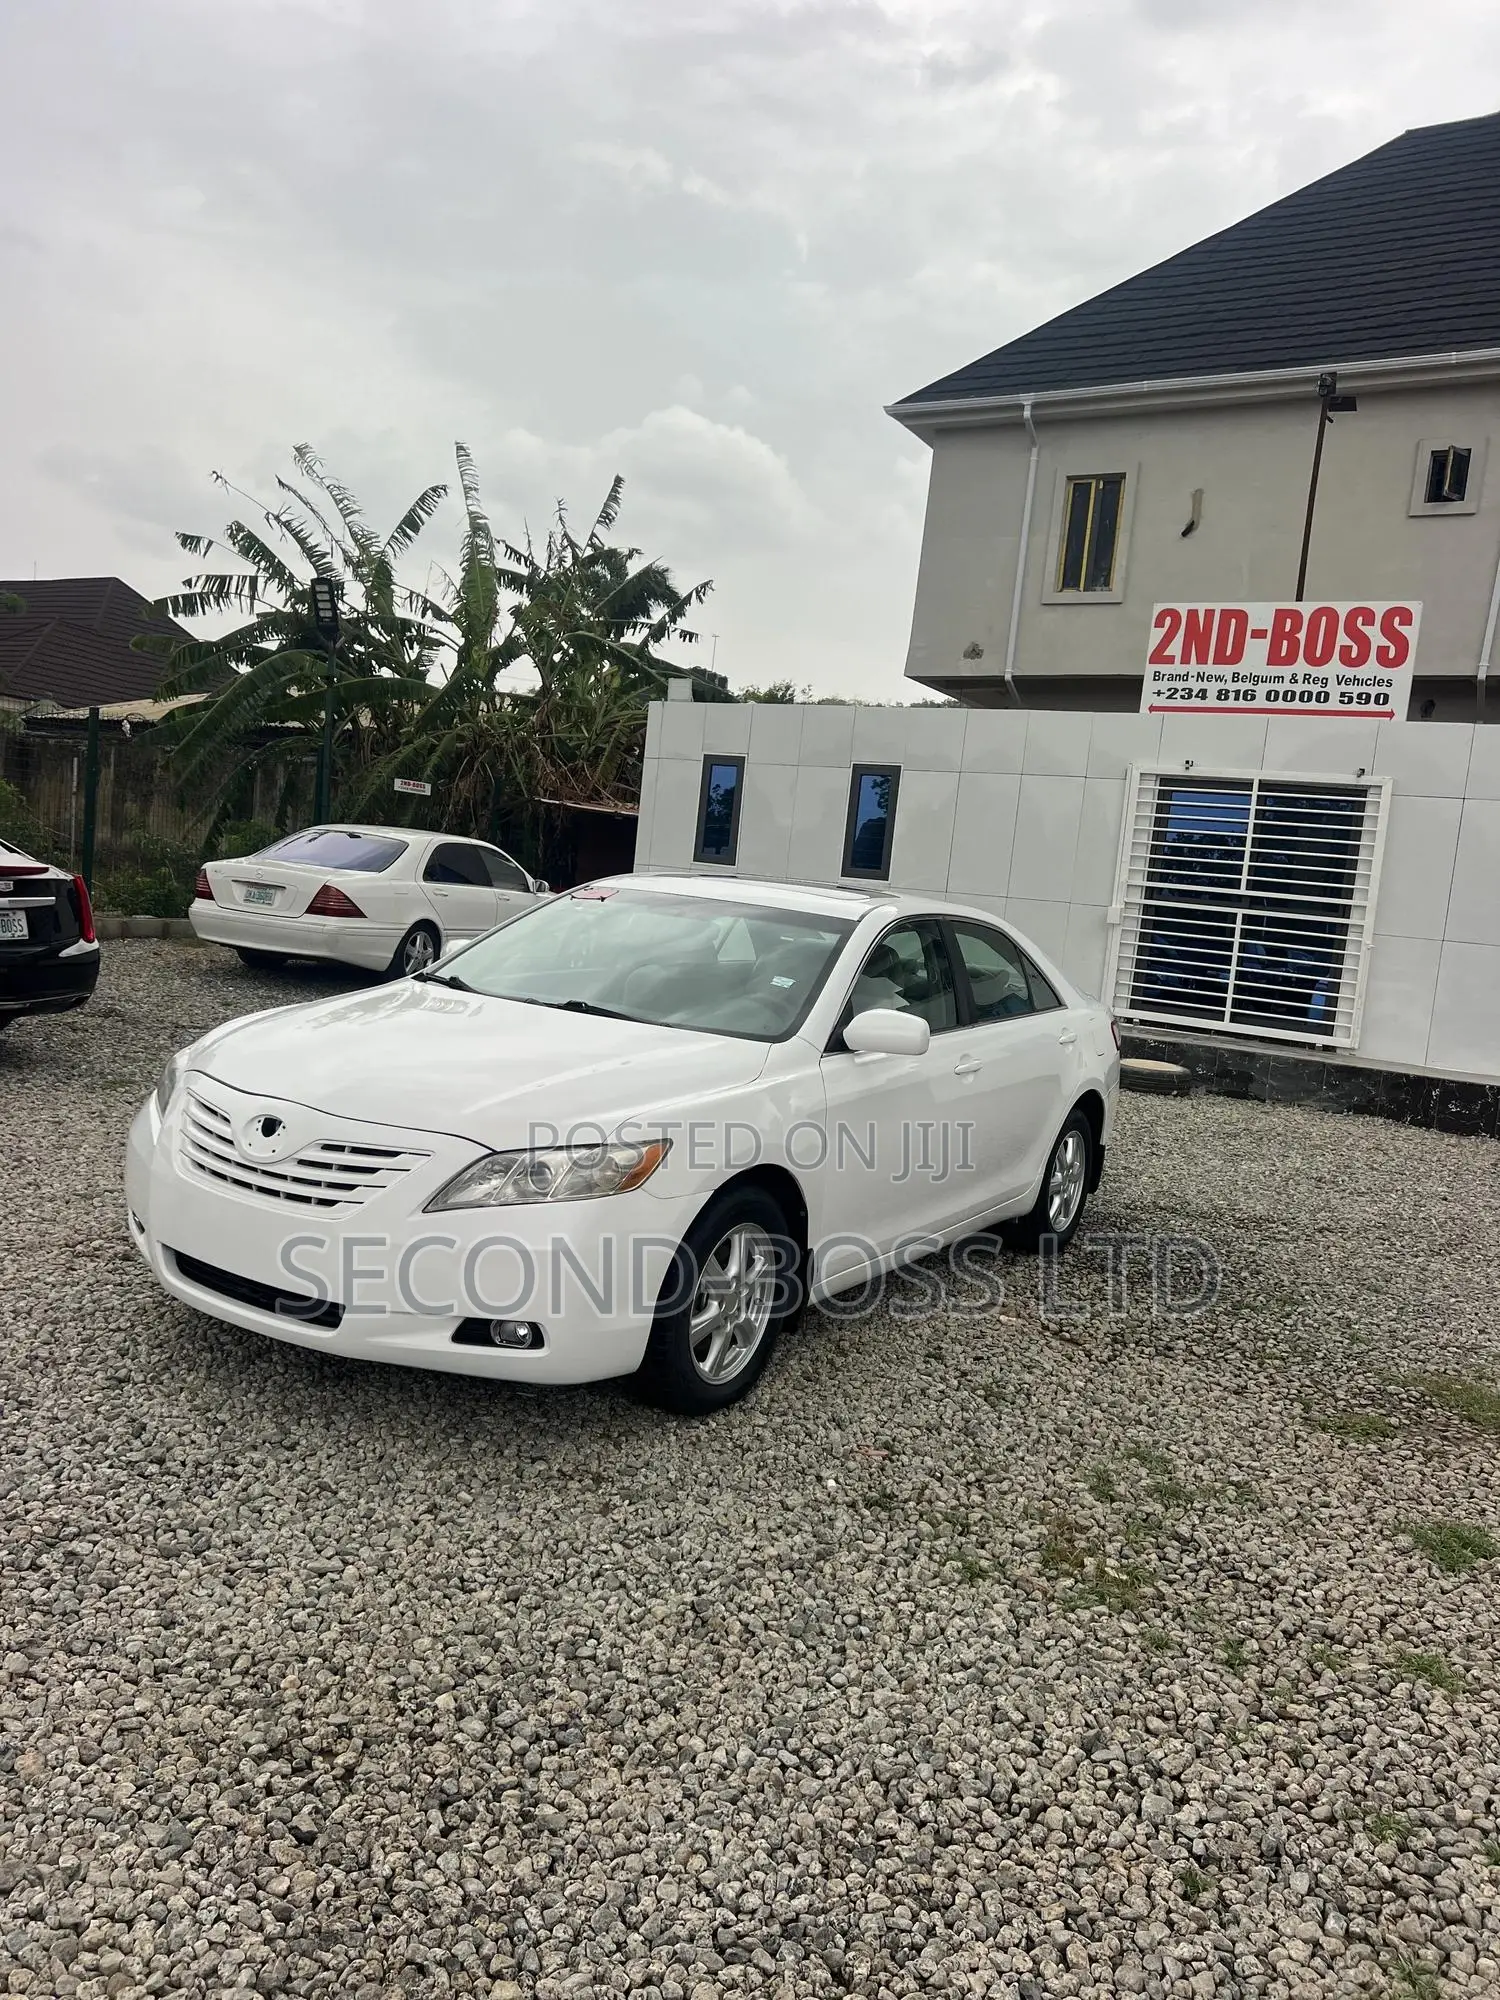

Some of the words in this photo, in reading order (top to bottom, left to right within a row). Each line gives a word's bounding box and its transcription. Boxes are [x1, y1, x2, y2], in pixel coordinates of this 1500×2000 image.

[1149, 606, 1413, 668] 2ND-BOSS
[1152, 670, 1228, 685] Brand-New,
[1231, 672, 1285, 686] Belguim
[1289, 673, 1299, 685] &
[1302, 673, 1329, 688] Reg
[1336, 674, 1394, 688] Vehicles
[1152, 687, 1209, 701] +234
[1216, 688, 1257, 702] 816
[1265, 689, 1330, 703] 0000
[1338, 691, 1390, 706] 590
